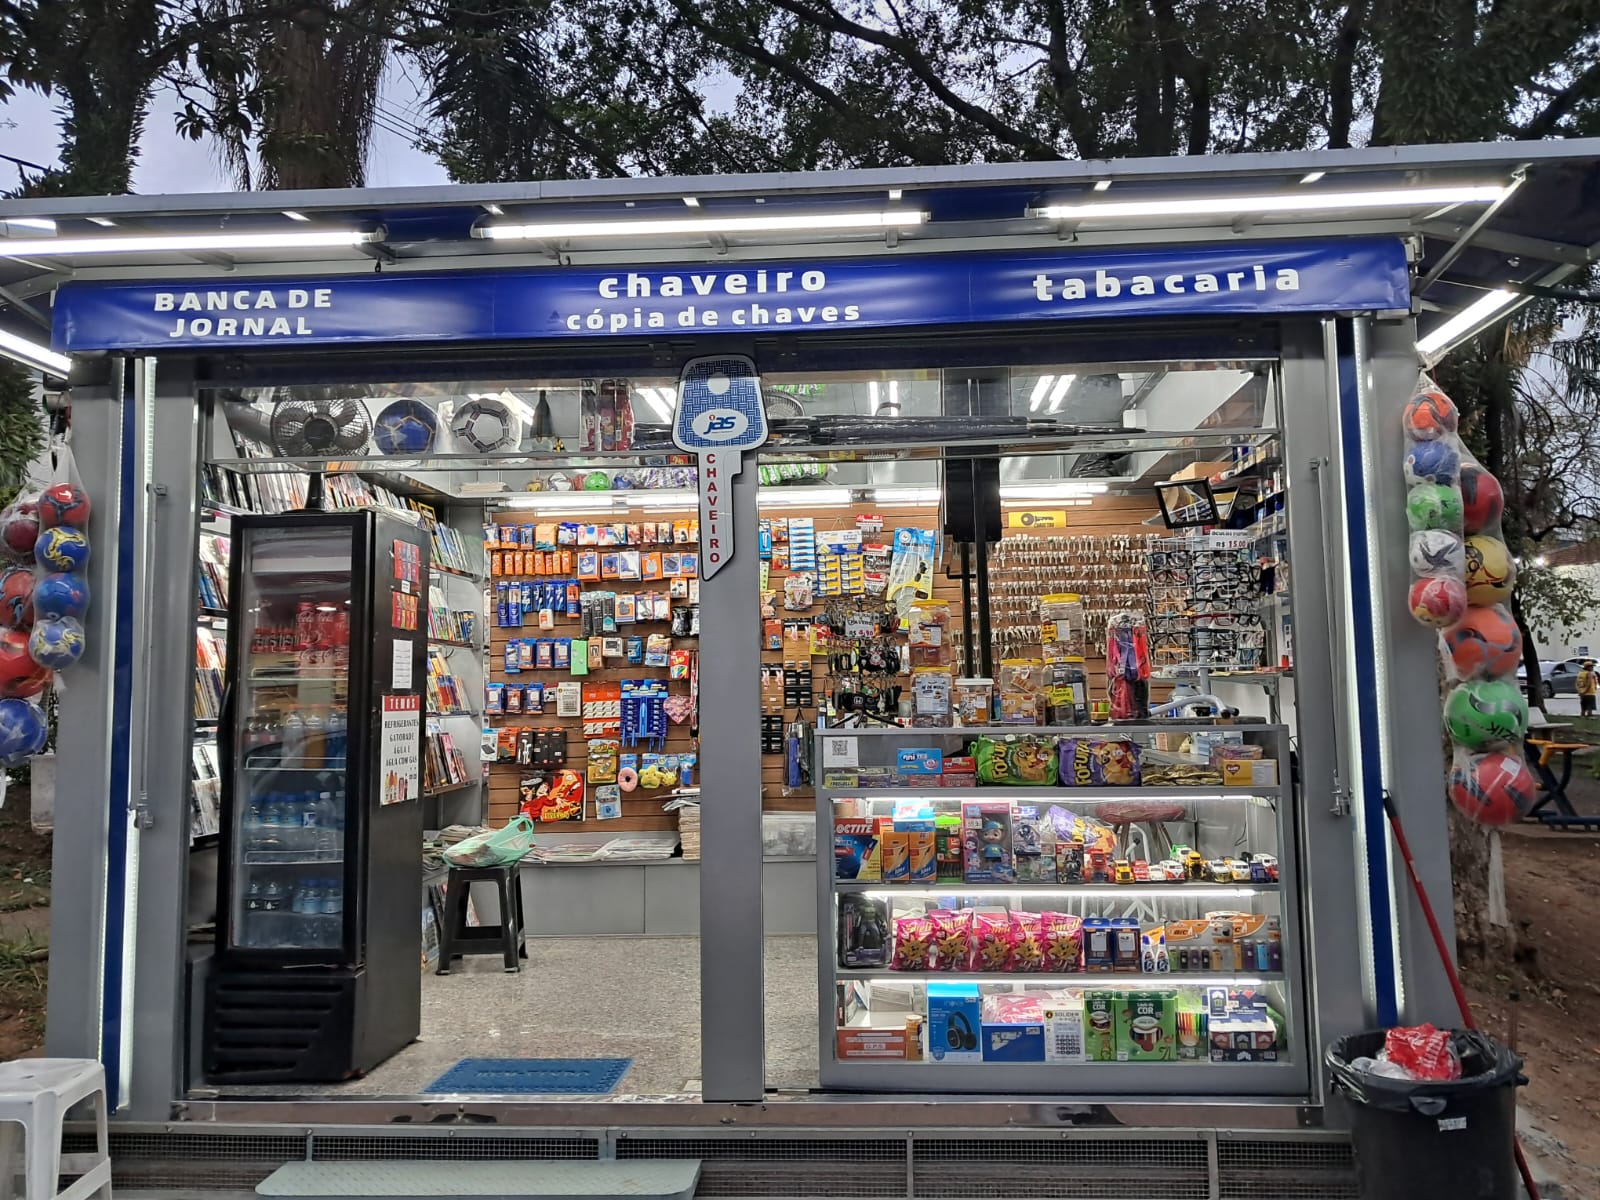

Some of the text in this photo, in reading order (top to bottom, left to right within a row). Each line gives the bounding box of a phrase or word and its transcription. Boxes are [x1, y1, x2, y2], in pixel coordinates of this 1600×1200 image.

[598, 270, 826, 299] chaveiro
[1032, 265, 1300, 302] tabacaria
[154, 288, 332, 313] BANCA DE
[169, 316, 313, 339] JORNAL
[566, 303, 860, 334] cópia de chaves
[706, 453, 720, 563] CHAVEIRO
[389, 698, 416, 710] TEMOS
[1137, 1007, 1154, 1015] COR
